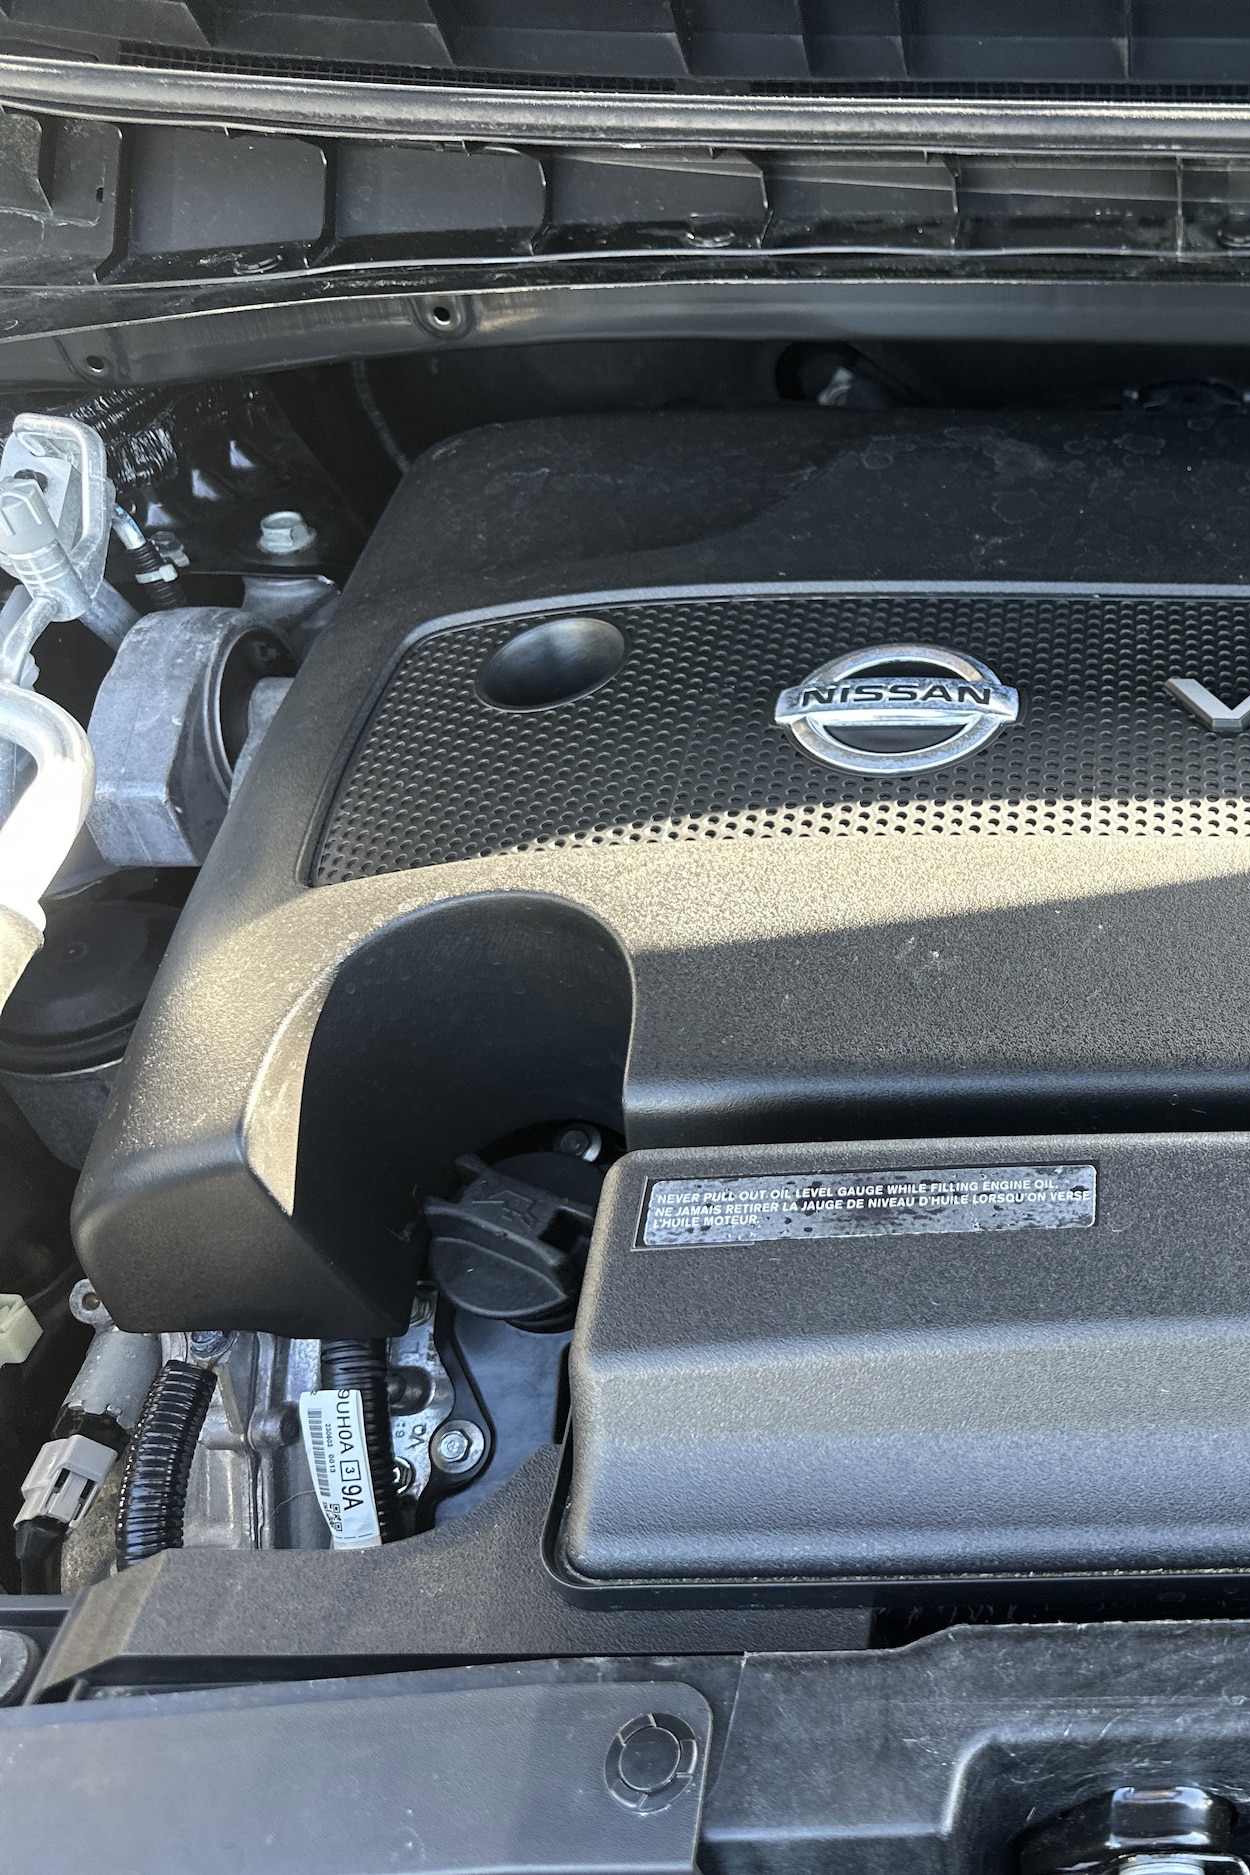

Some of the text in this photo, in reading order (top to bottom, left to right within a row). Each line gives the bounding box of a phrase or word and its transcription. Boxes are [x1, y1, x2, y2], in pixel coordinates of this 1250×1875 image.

[801, 683, 991, 708] NISSAN
[654, 1191, 1091, 1217] NE JAMAIS RETIRER LA JAUGE DE NIVEAU D'HUILE LORSQU'ON VERSE
[658, 1179, 1058, 1204] NEVER PULL OUT OIL LEVEL GAUGE WHILE FILLING ENGINE OIL.
[653, 1214, 760, 1229] L'HUILE MOTEUR.
[341, 1484, 364, 1511] 9A
